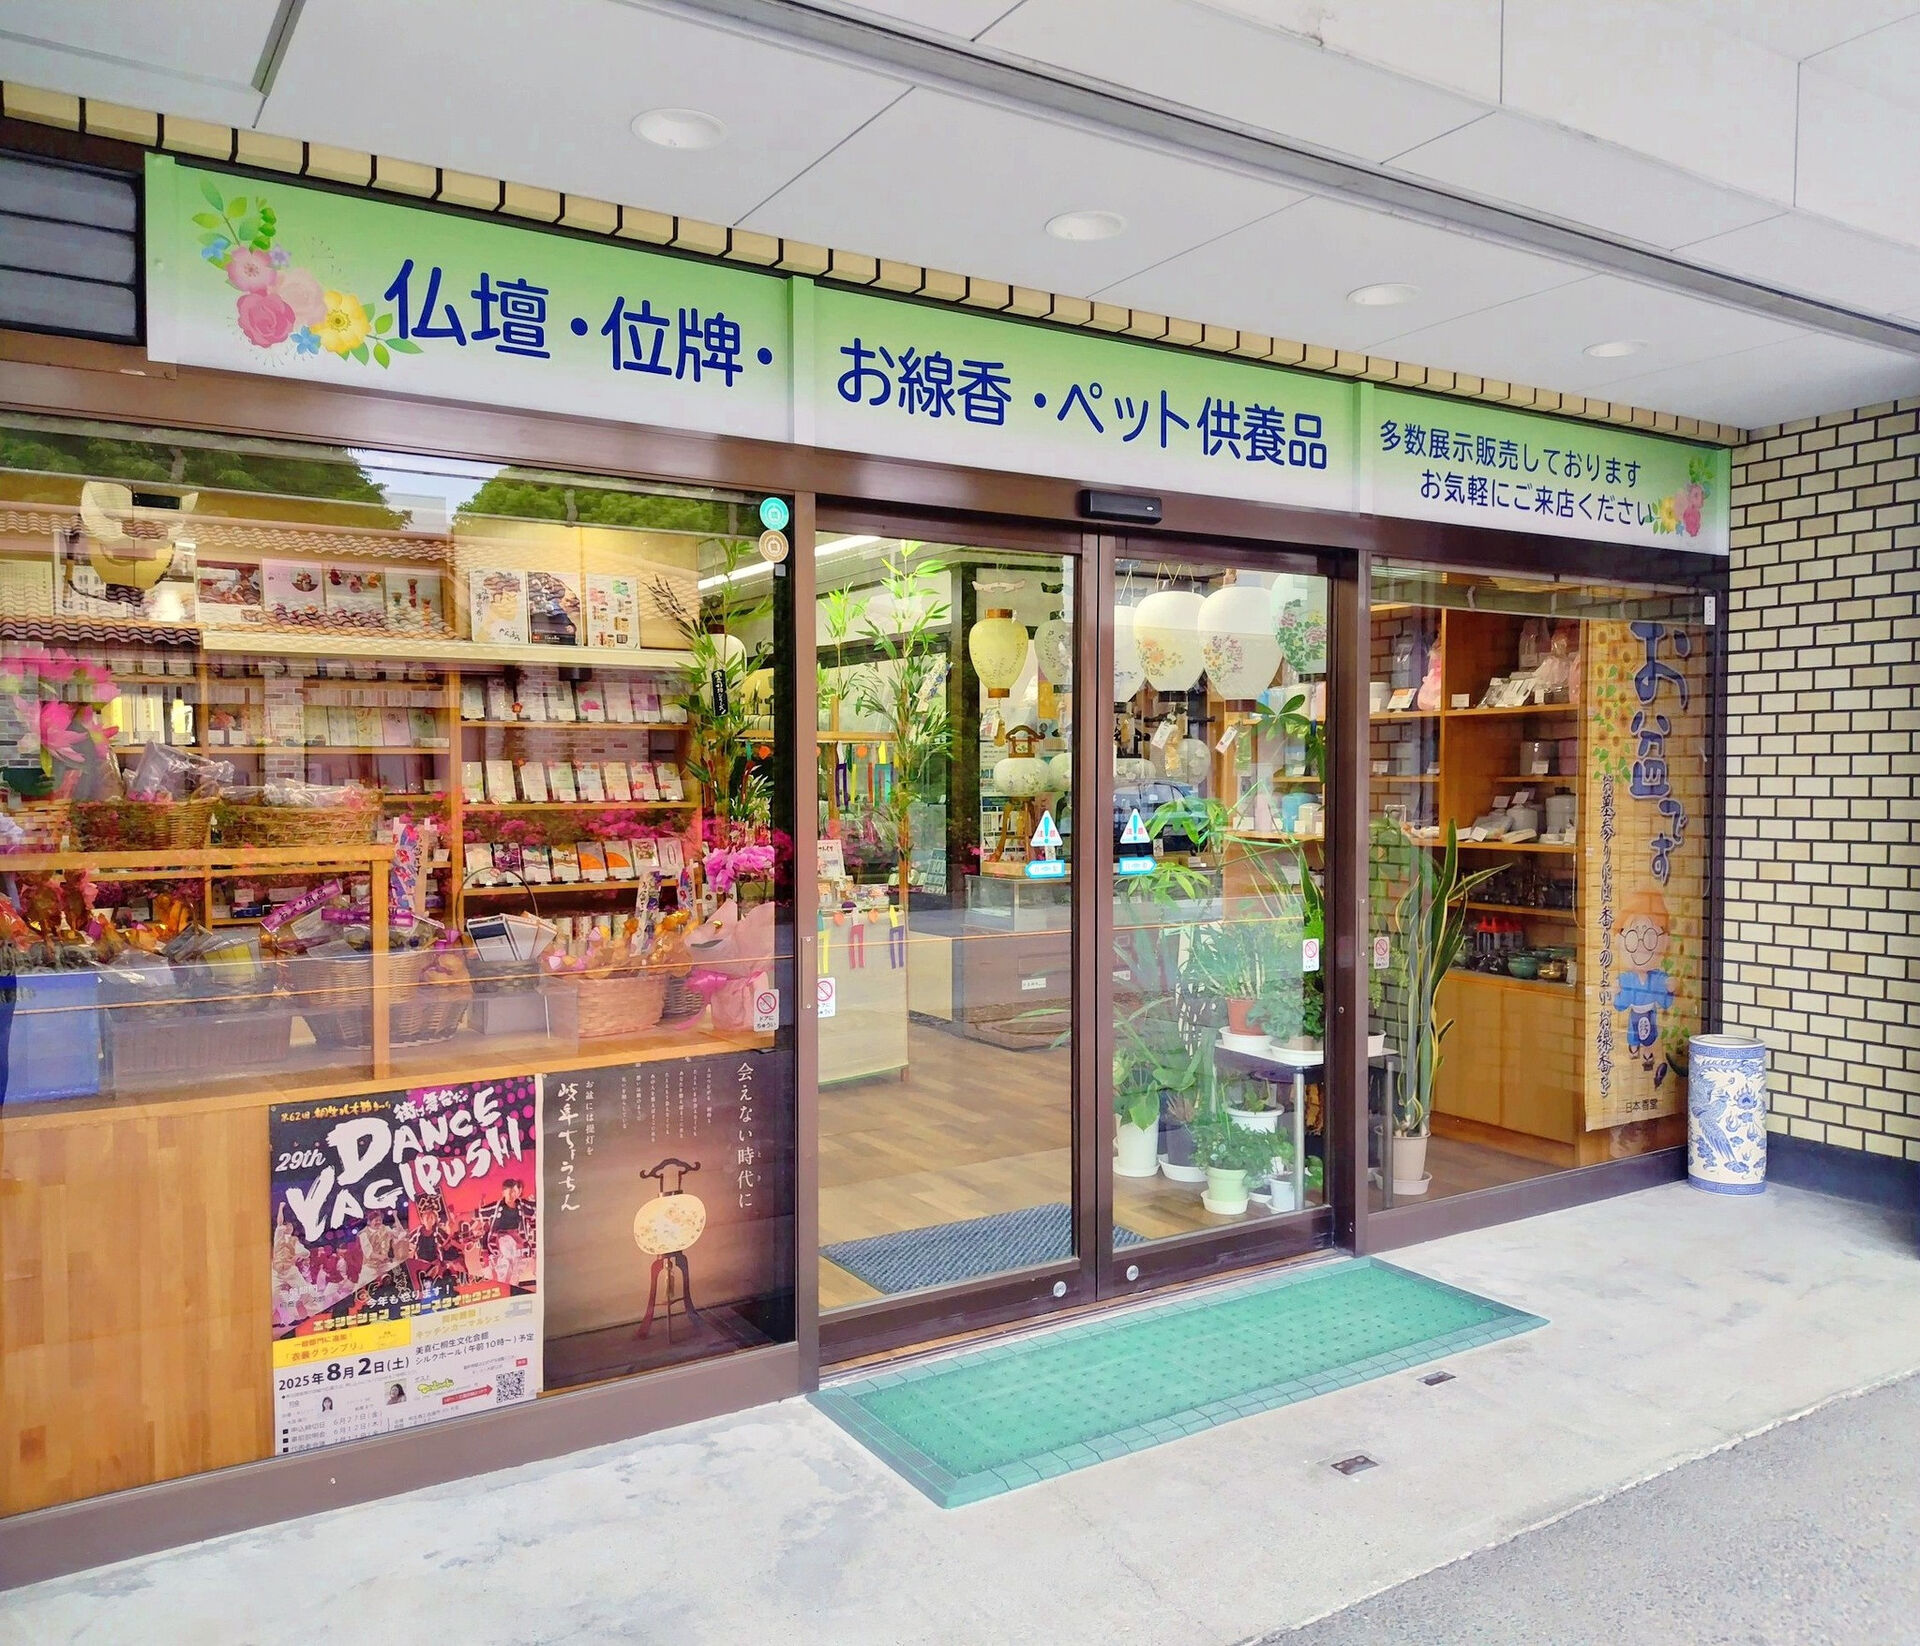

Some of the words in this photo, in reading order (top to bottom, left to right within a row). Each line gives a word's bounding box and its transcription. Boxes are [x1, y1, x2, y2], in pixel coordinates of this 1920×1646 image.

[837, 337, 1327, 470] お線香・ペット供養品
[1380, 420, 1641, 487] 多数展示販売しております
[1420, 469, 1654, 526] お気軽にご来店ください
[275, 1149, 326, 1173] 29th
[326, 1086, 501, 1186] DANCE
[558, 1083, 580, 1211] 岐阜ちょうちん
[585, 1081, 595, 1155] お盆には提灯を
[737, 1062, 754, 1208] 会えない時代に
